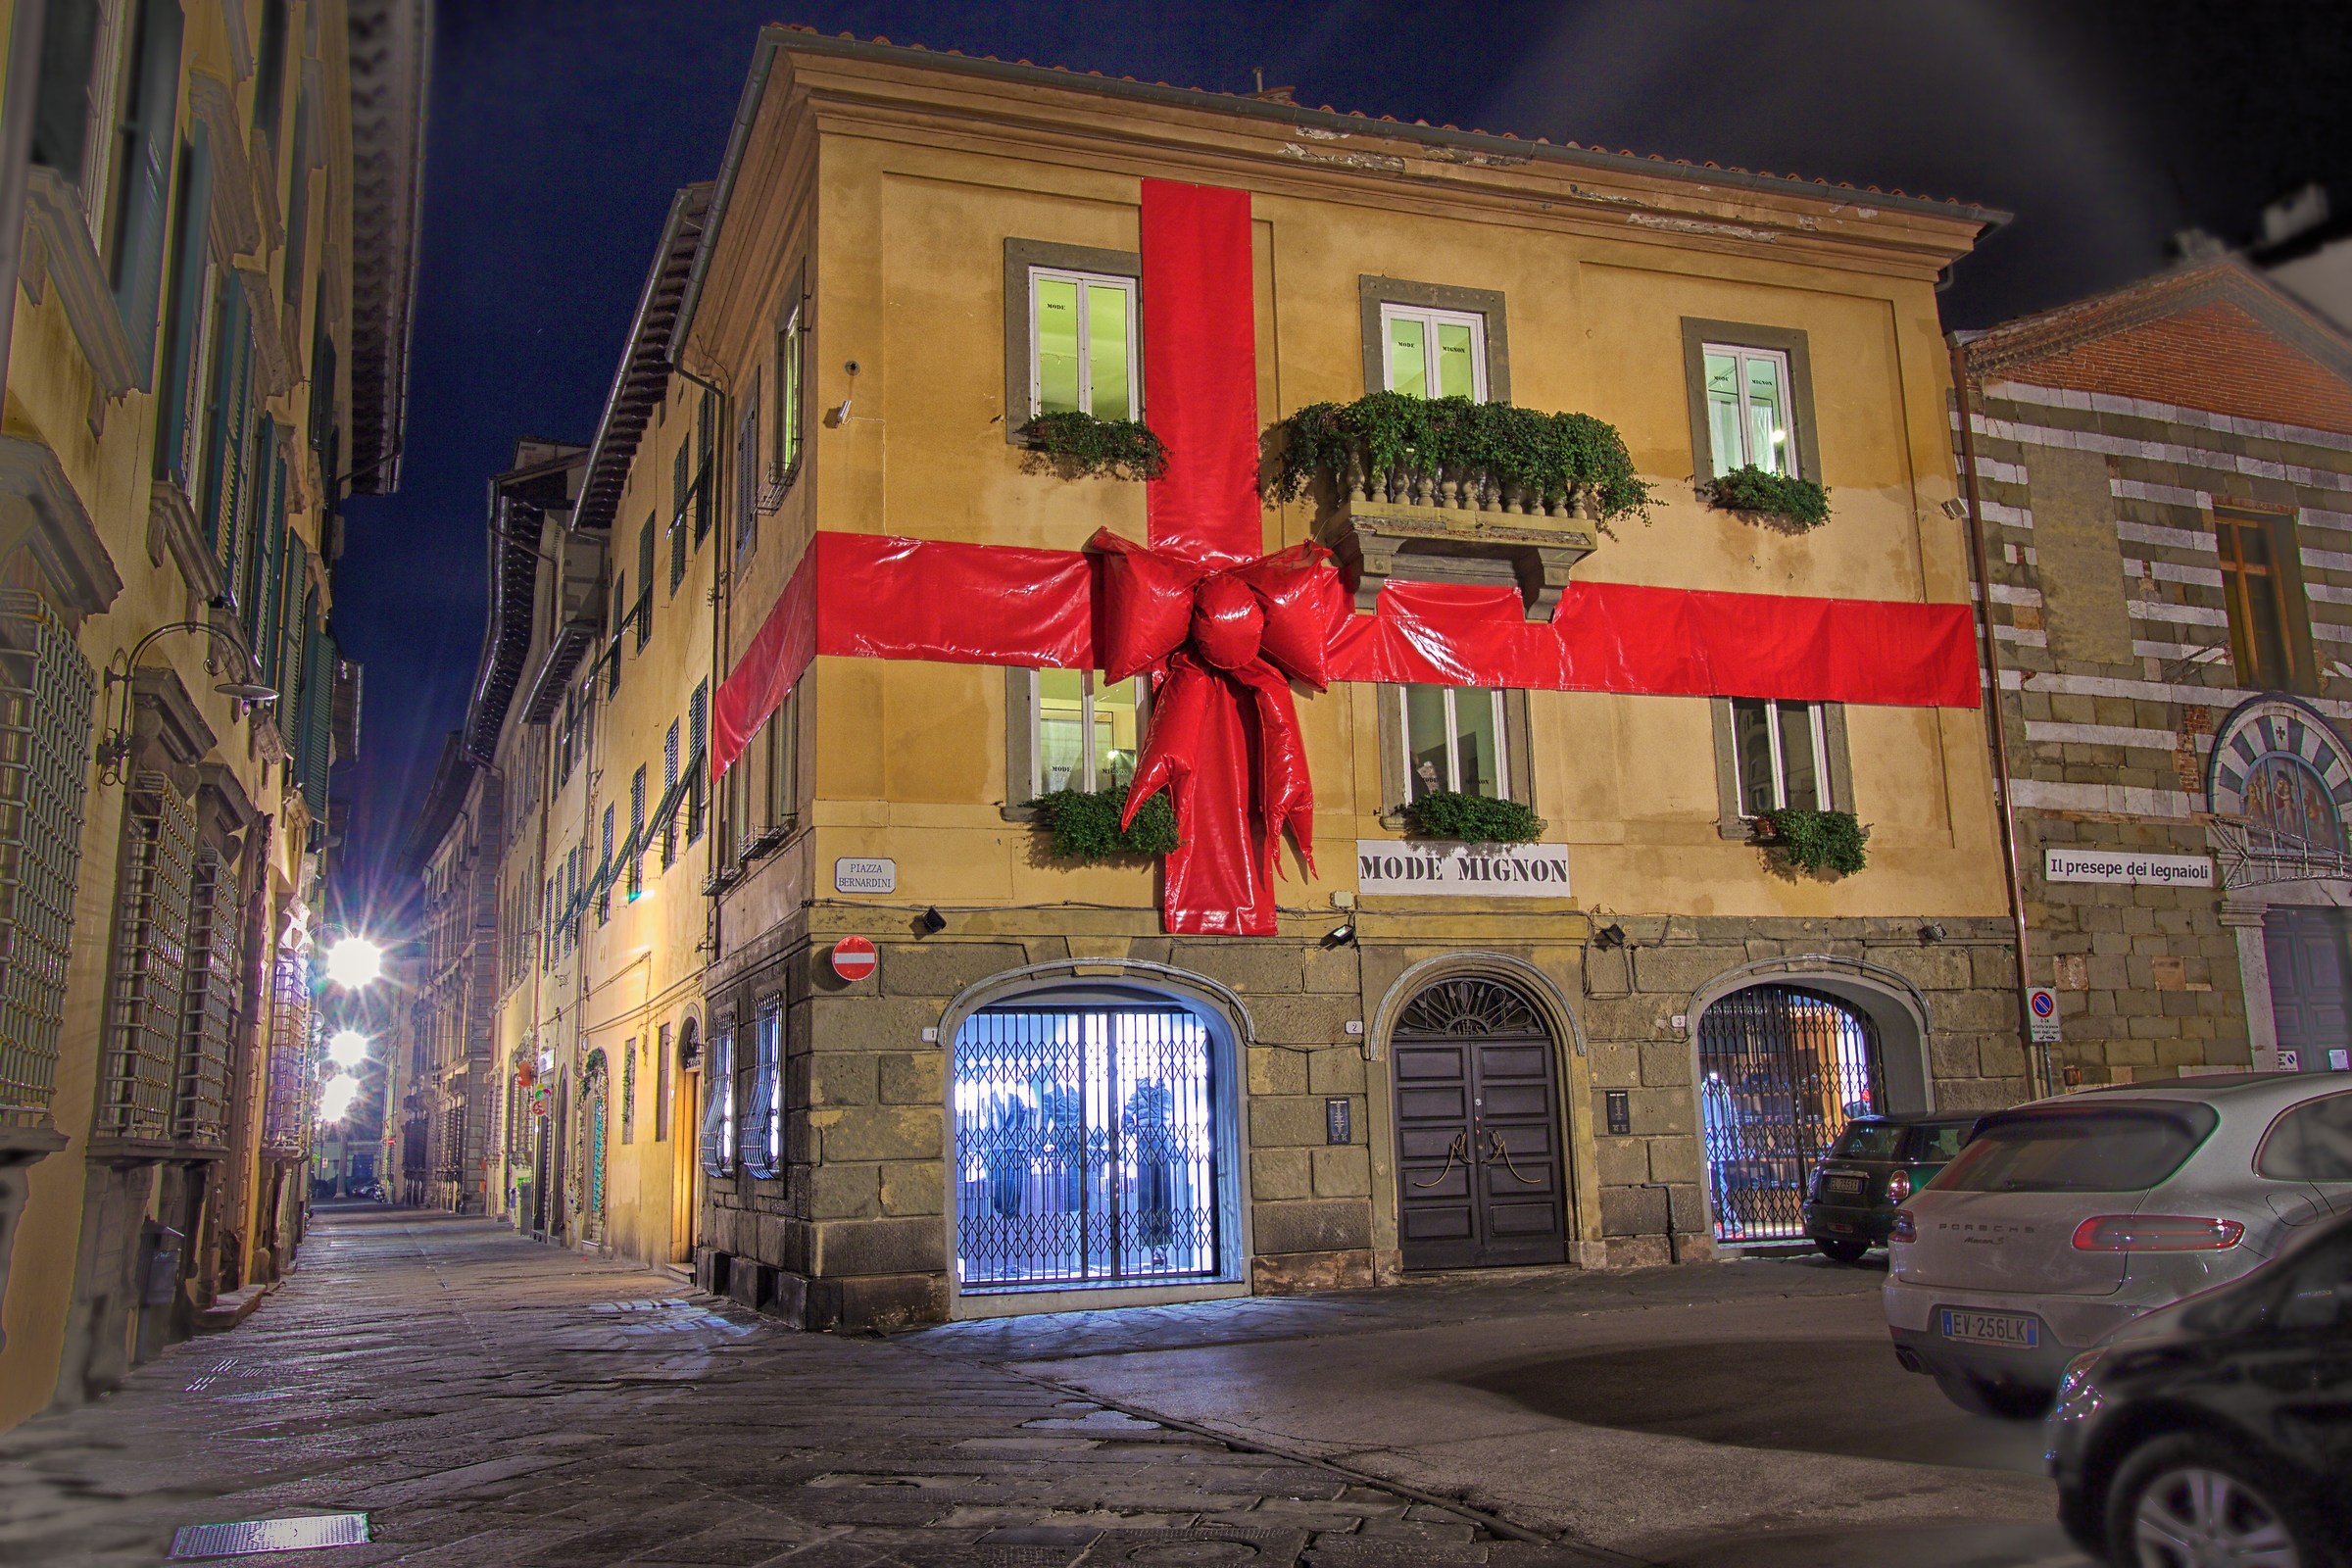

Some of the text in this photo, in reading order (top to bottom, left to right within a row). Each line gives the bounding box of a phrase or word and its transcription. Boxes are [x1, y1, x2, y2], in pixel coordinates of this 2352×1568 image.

[1047, 302, 1066, 312] MODE
[1442, 345, 1466, 354] MIGNON
[850, 863, 883, 873] PIAZZA
[1359, 856, 1568, 883] MODE MIGNON
[2051, 858, 2209, 881] Il presepe dei legnaioli
[838, 877, 892, 888] BERNARDINI
[1677, 1017, 1683, 1026] 3
[1351, 1022, 1358, 1032] 2
[1939, 1223, 2035, 1233] PORSCHE
[1953, 1314, 1971, 1335] EV
[1977, 1317, 2026, 1342] 256LK
